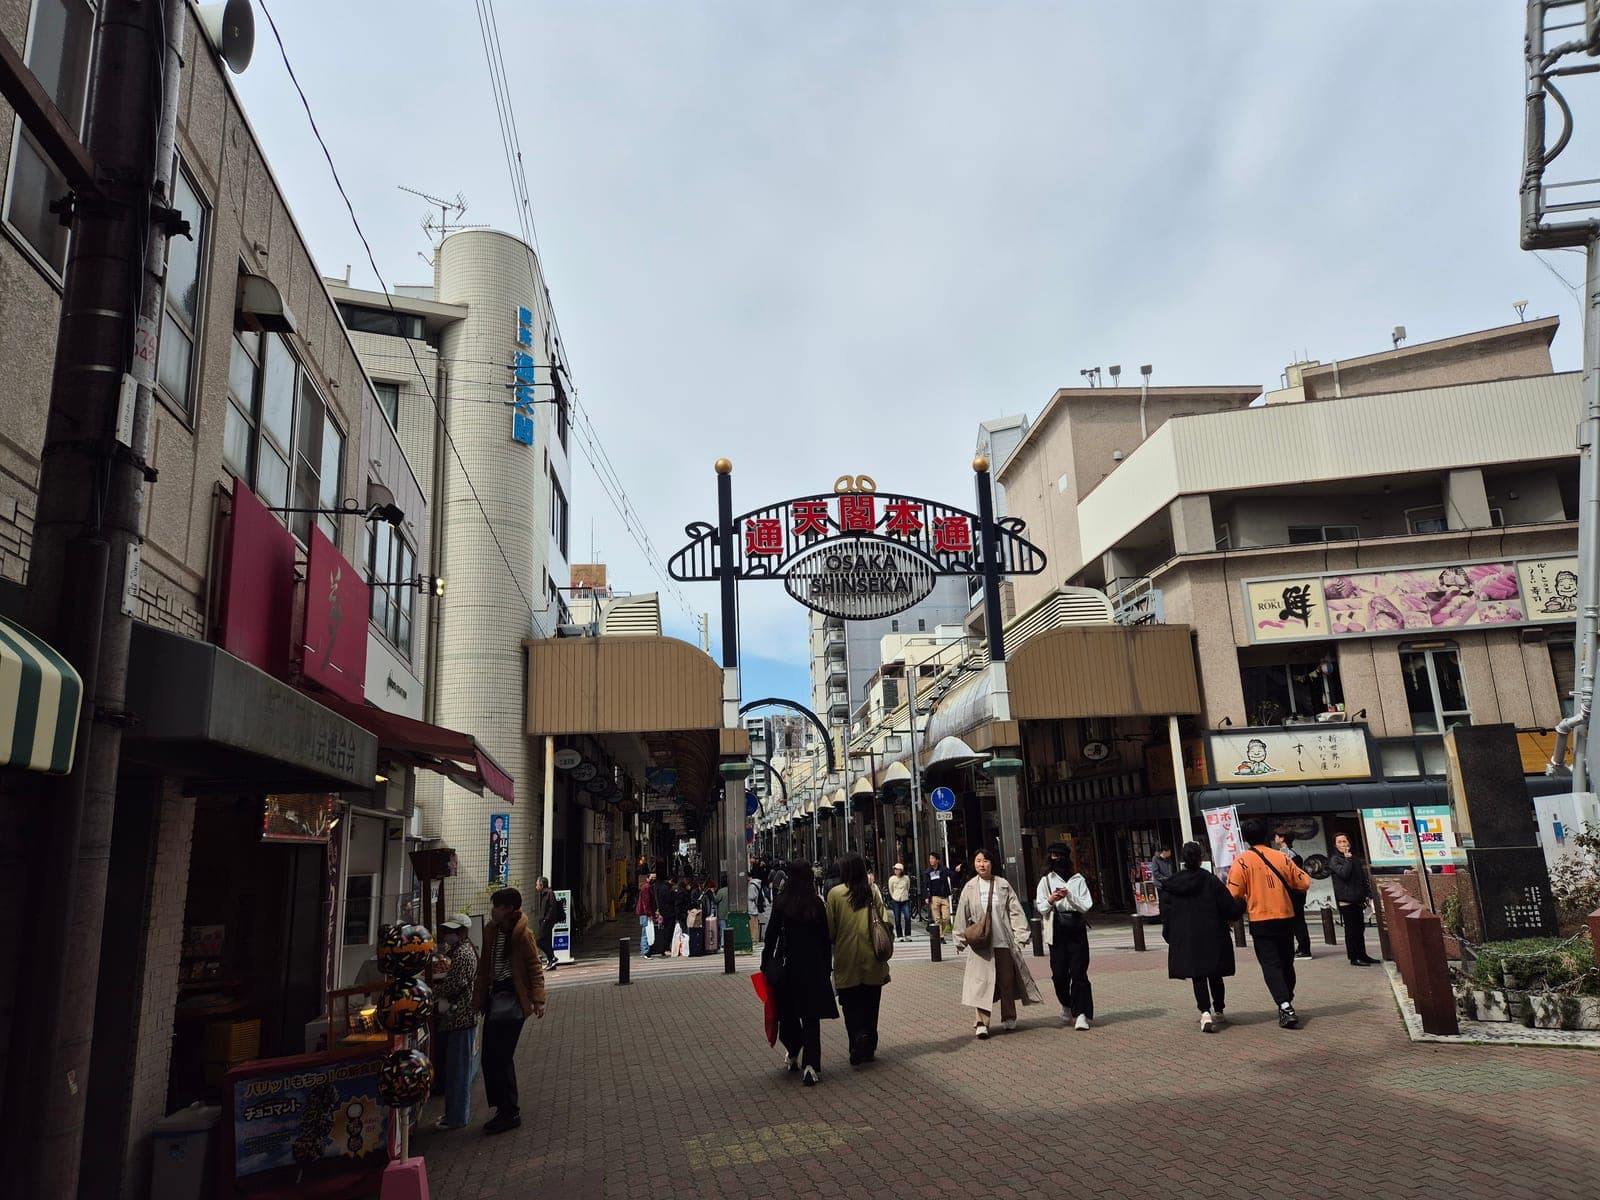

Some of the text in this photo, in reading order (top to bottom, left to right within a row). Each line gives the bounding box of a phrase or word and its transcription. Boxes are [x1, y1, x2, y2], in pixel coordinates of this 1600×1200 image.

[744, 495, 974, 556] 通天閣本通
[826, 555, 898, 572] OSAKA
[810, 577, 914, 595] SHINSEKAI
[1292, 742, 1305, 772] すし
